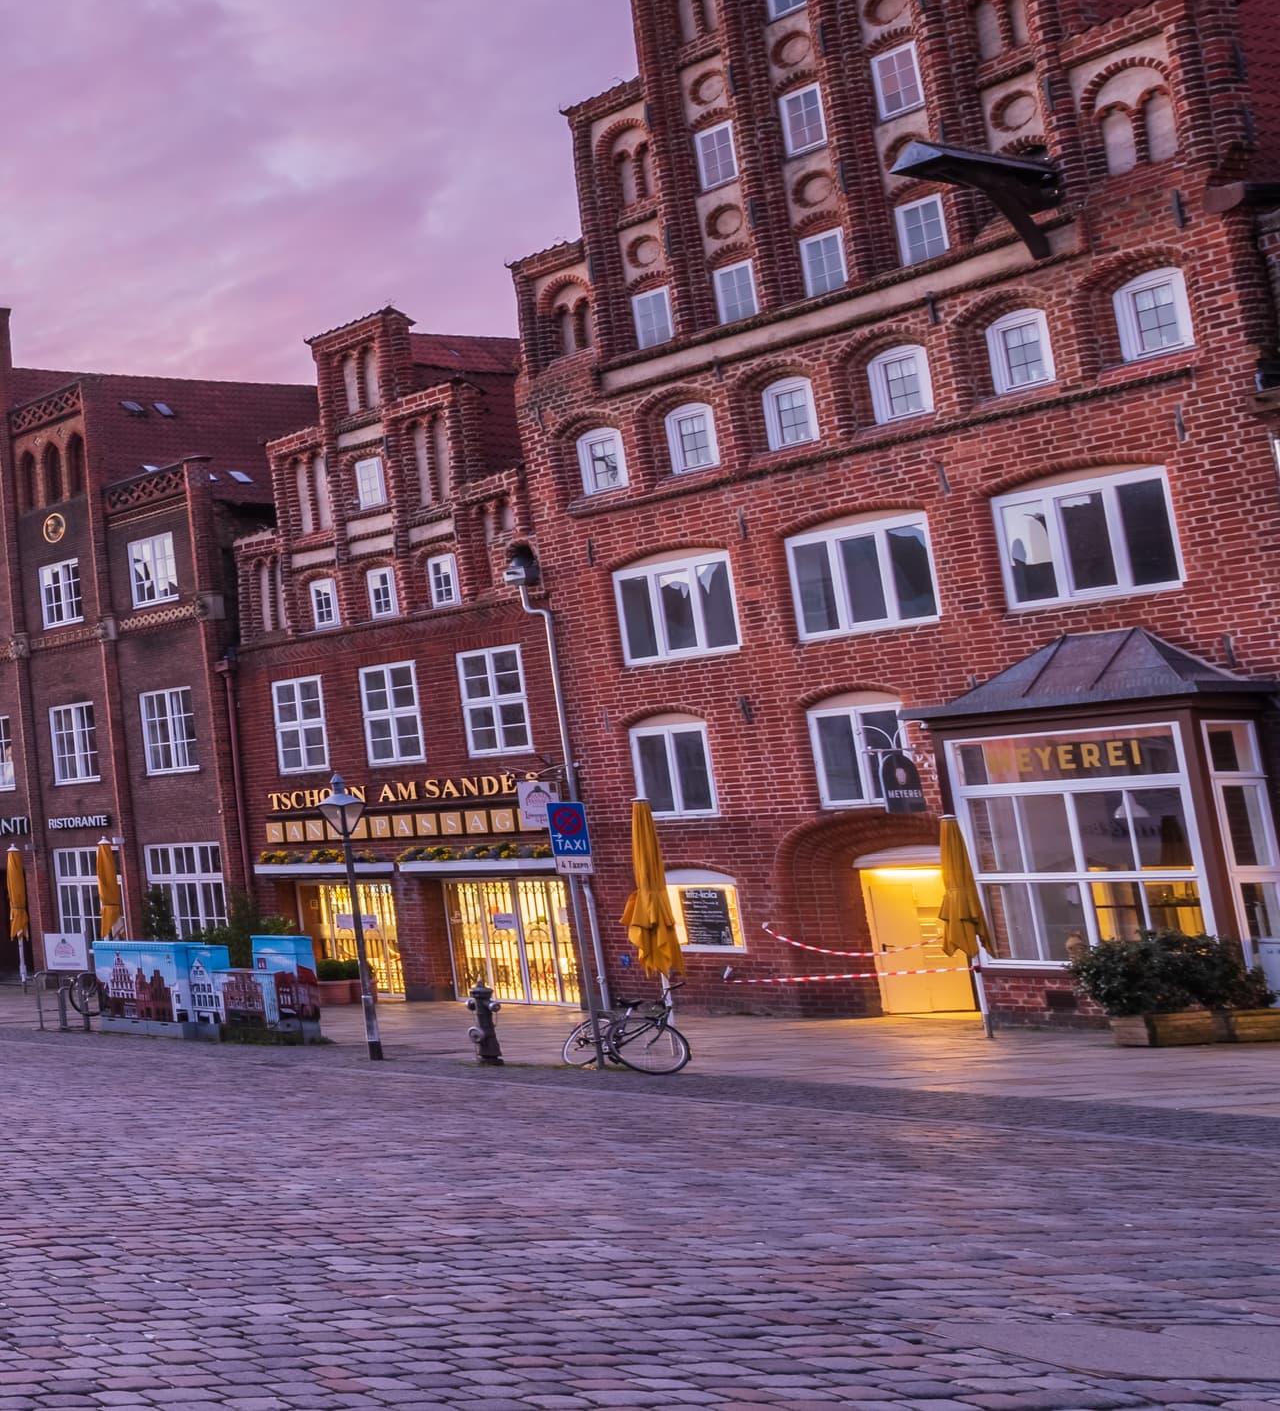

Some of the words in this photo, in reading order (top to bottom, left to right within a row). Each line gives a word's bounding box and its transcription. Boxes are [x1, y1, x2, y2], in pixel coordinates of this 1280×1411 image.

[989, 739, 1144, 774] MEYEREI
[268, 785, 368, 811] TSCHON
[378, 781, 417, 802] AM
[425, 773, 518, 799] SANDE
[887, 790, 923, 799] MEYEREI
[48, 815, 108, 830] RISTORANTE
[555, 839, 587, 851] TAXI
[568, 860, 589, 869] Taxen
